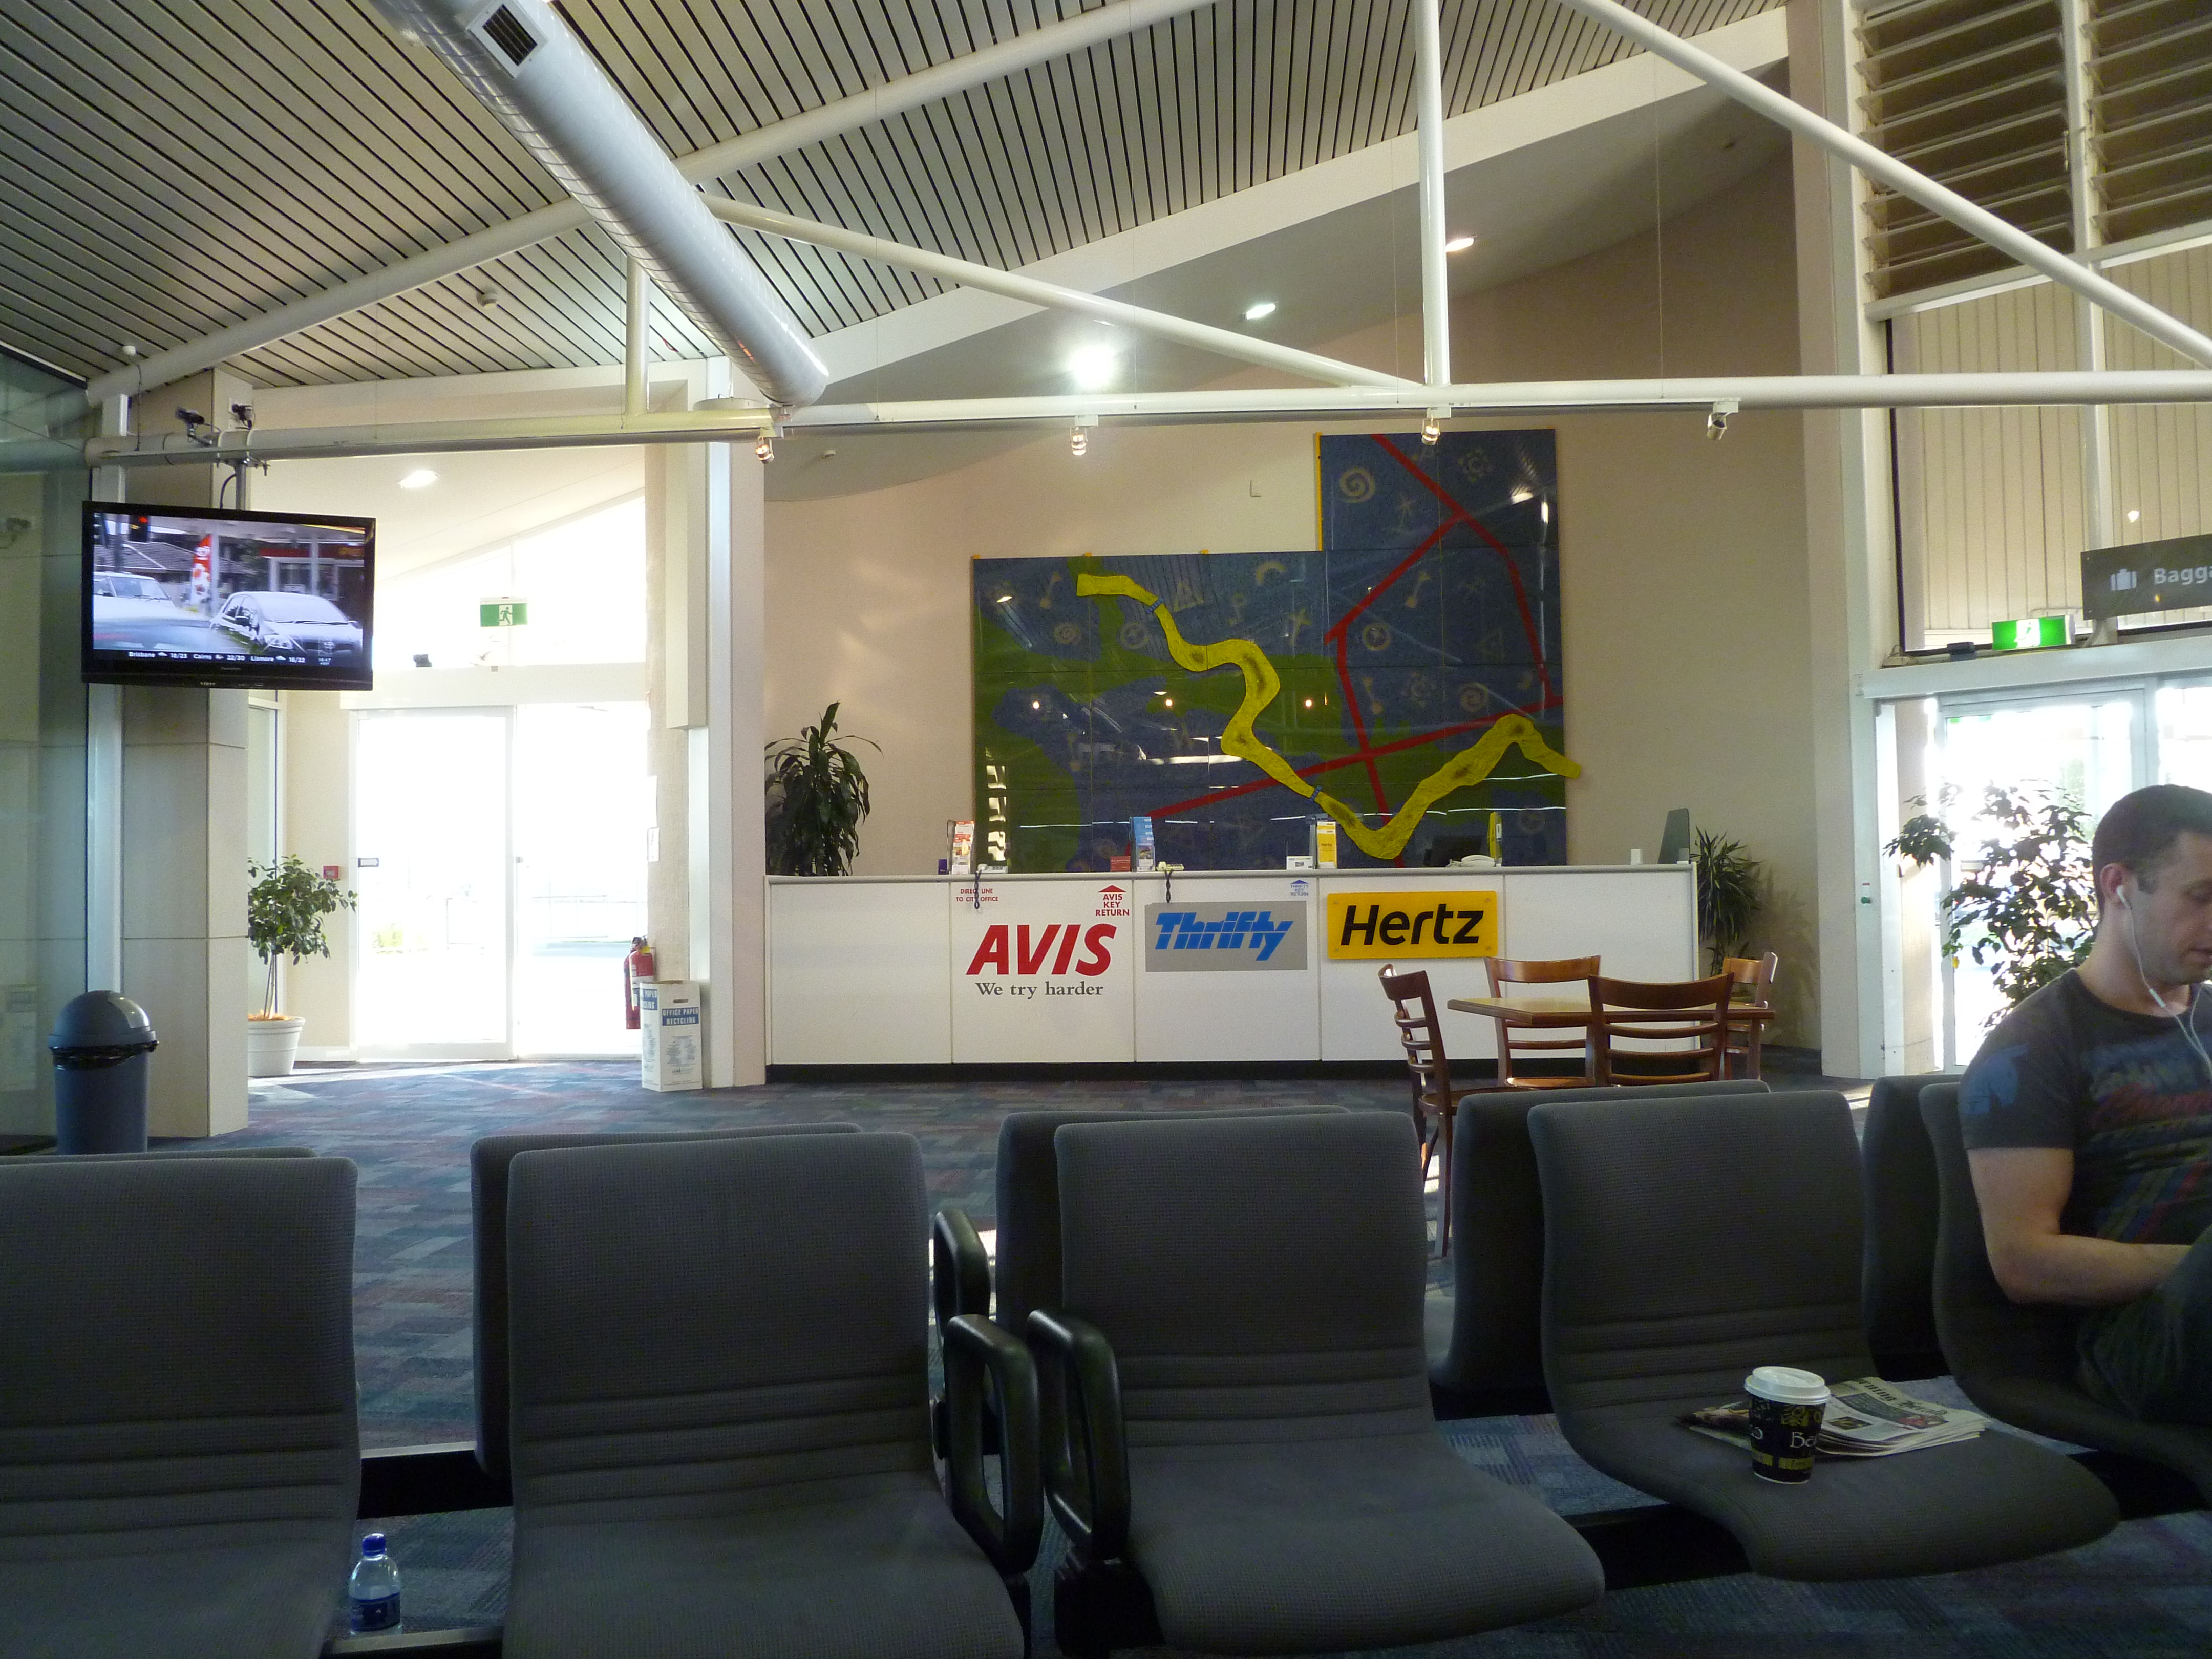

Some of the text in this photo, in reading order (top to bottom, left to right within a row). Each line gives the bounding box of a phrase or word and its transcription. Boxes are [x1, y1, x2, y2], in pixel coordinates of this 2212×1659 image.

[1155, 911, 1294, 961] Thrifty
[1340, 903, 1484, 946] Hertz
[965, 923, 1117, 976] AVIS
[975, 981, 1103, 999] We try harder
[666, 1016, 696, 1025] RECYCLING
[683, 1007, 699, 1015] PAPER
